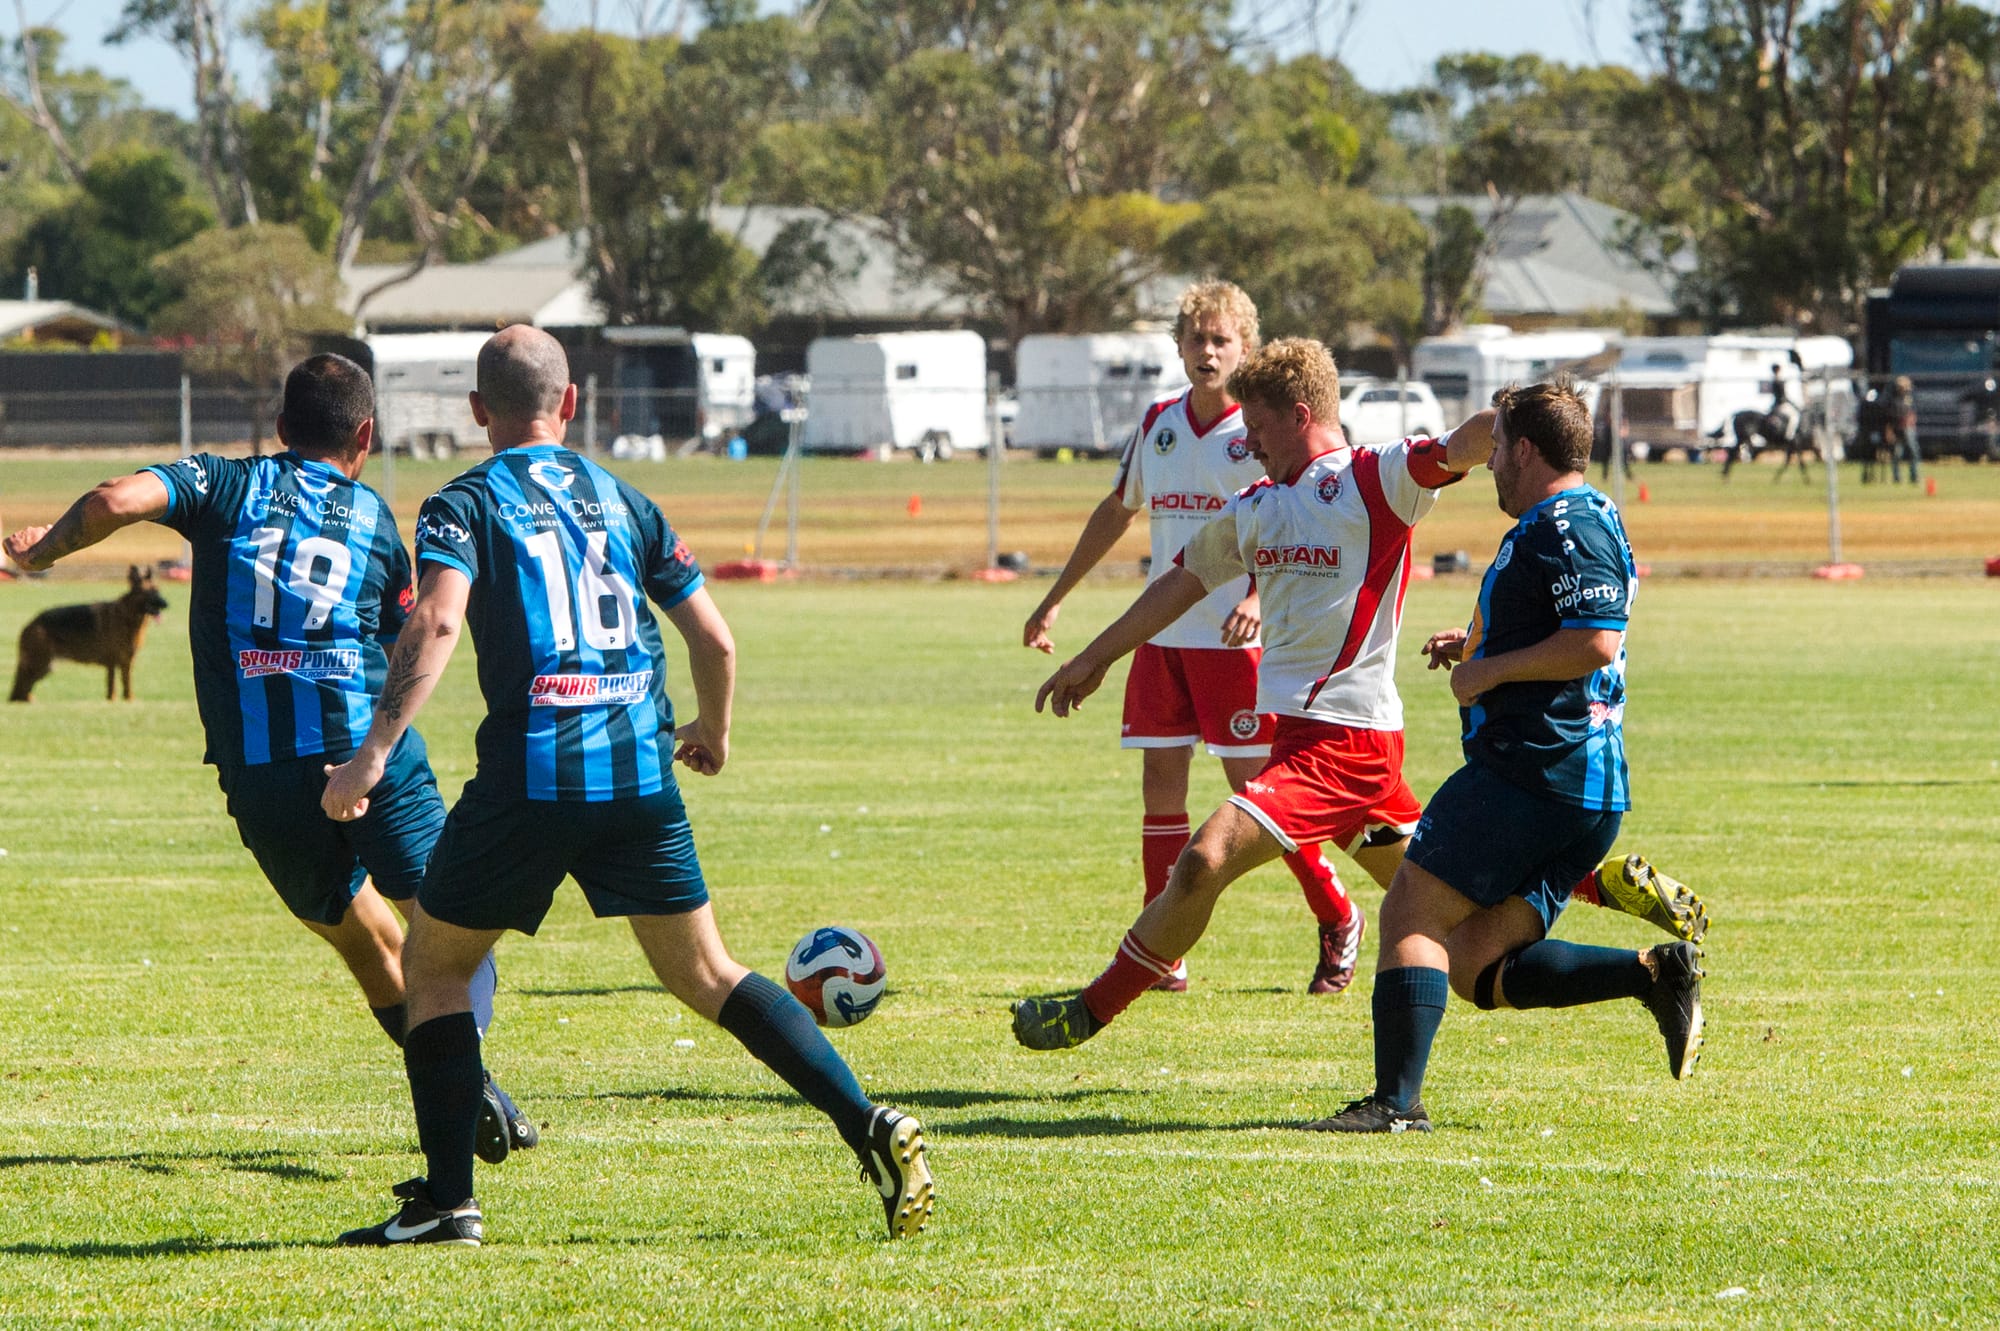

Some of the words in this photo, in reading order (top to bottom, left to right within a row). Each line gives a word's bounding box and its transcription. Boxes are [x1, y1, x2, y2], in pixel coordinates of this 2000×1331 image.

[249, 487, 309, 512] Cowell
[316, 500, 375, 529] Clarke
[567, 498, 628, 518] Clarke
[1151, 494, 1228, 511] HOLTA
[1255, 545, 1341, 568] OLTAN
[249, 527, 352, 630] 19
[524, 530, 637, 651] 16
